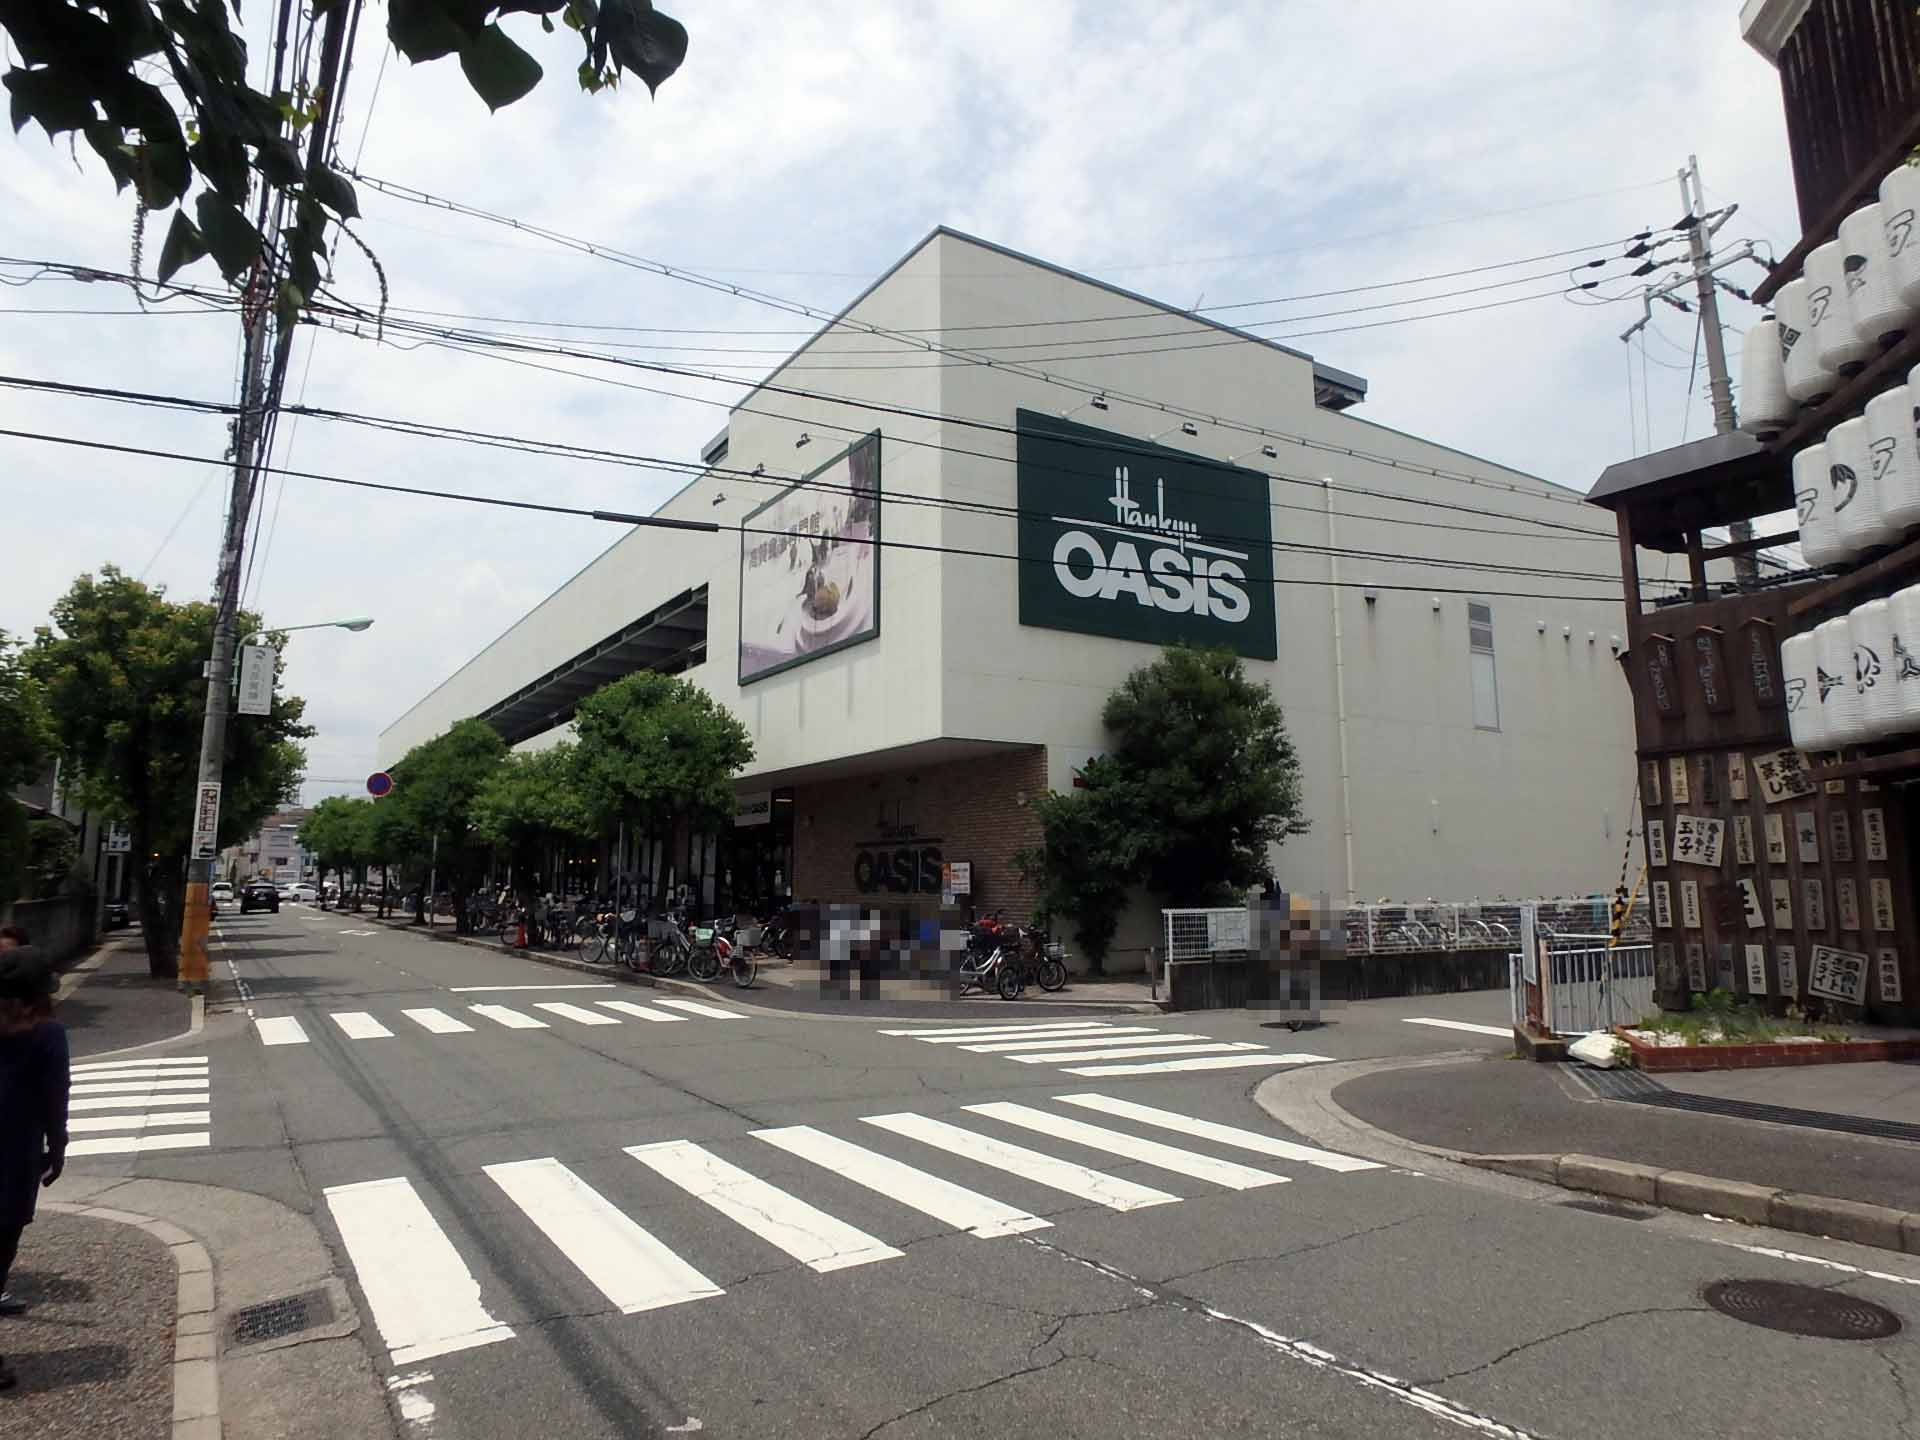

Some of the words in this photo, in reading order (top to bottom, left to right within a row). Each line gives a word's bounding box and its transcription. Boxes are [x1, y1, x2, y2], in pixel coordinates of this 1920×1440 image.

[1108, 466, 1201, 553] Hankyu
[1052, 530, 1250, 623] OASIS
[855, 848, 942, 894] OASIS
